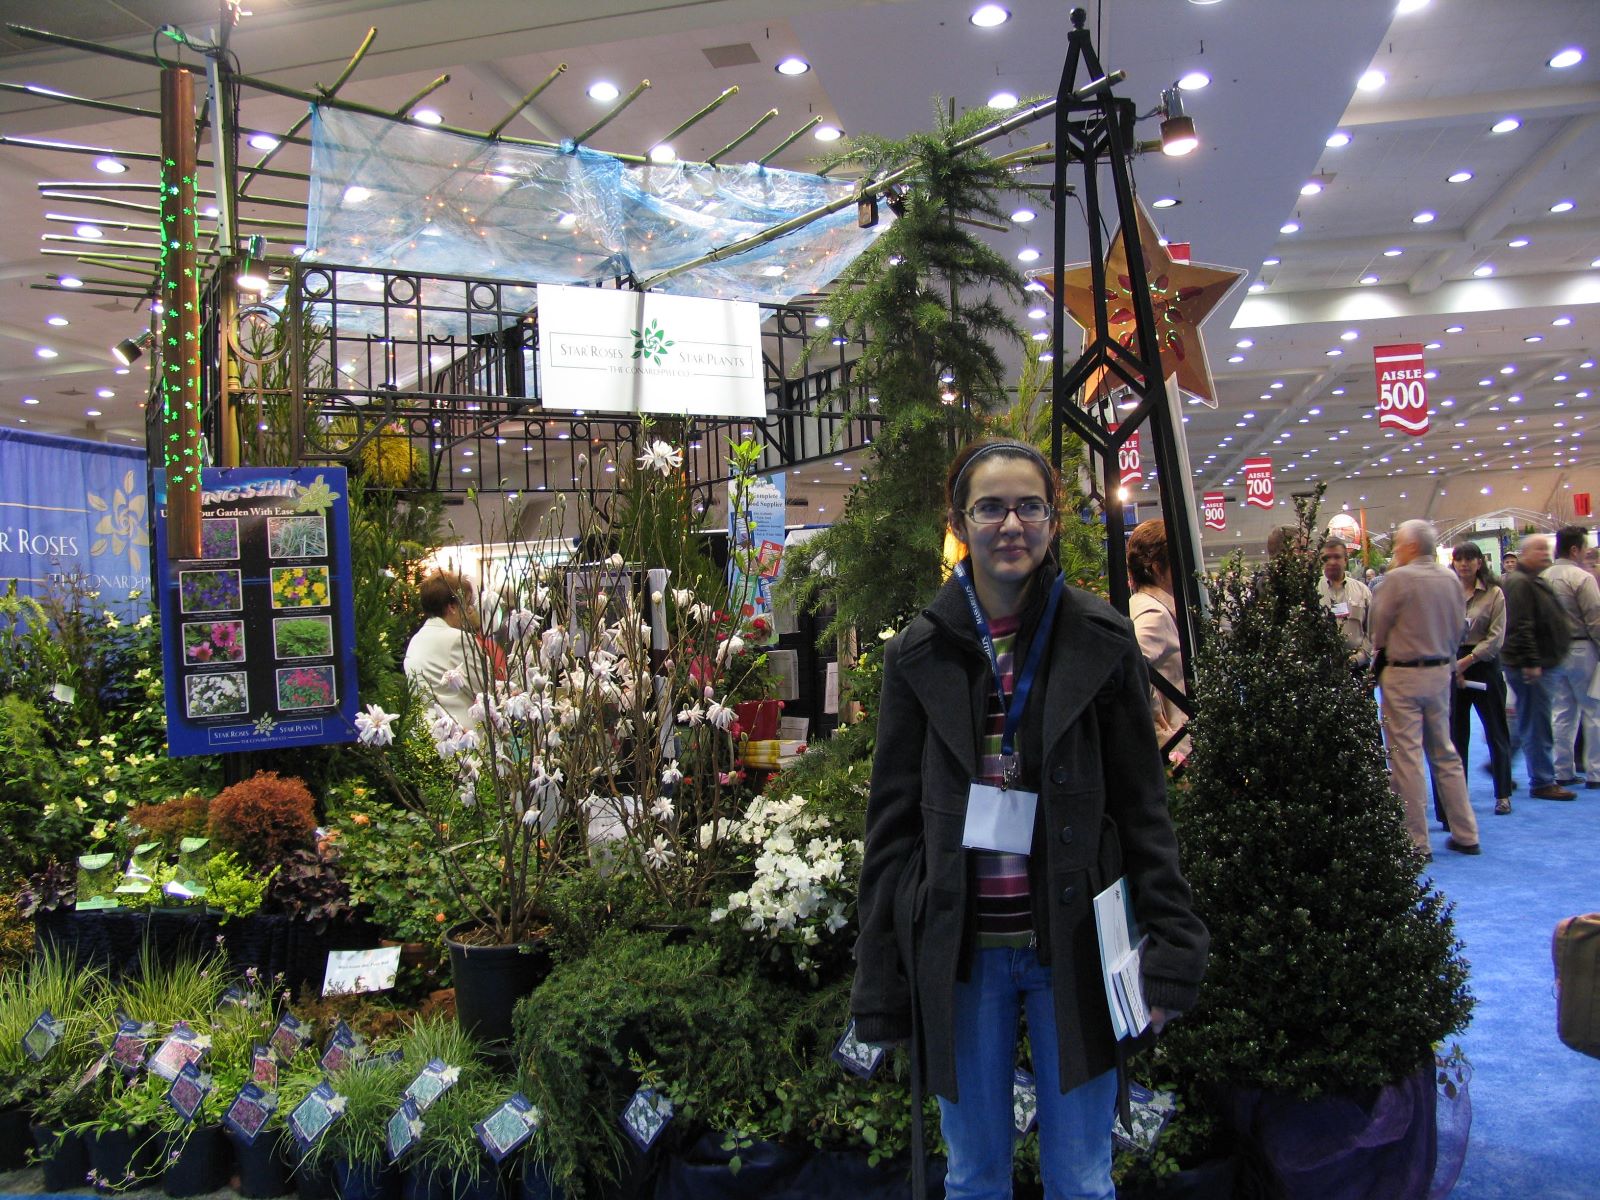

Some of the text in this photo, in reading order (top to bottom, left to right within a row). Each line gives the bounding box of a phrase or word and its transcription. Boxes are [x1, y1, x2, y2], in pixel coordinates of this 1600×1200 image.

[560, 344, 624, 359] STAR ROSES
[680, 352, 745, 368] STAR PLANTS
[609, 365, 623, 374] THE
[1382, 369, 1422, 381] AISLE
[1381, 381, 1425, 411] 500
[1118, 449, 1140, 471] 00
[241, 479, 298, 499] STAR
[1246, 478, 1272, 495] 700
[216, 507, 249, 517] Garden
[249, 507, 273, 516] With
[275, 506, 295, 515] Ease
[1205, 508, 1225, 521] 900
[18, 528, 79, 557] ROSES
[214, 730, 249, 739] STAR ROSES
[295, 724, 318, 732] PLANTS
